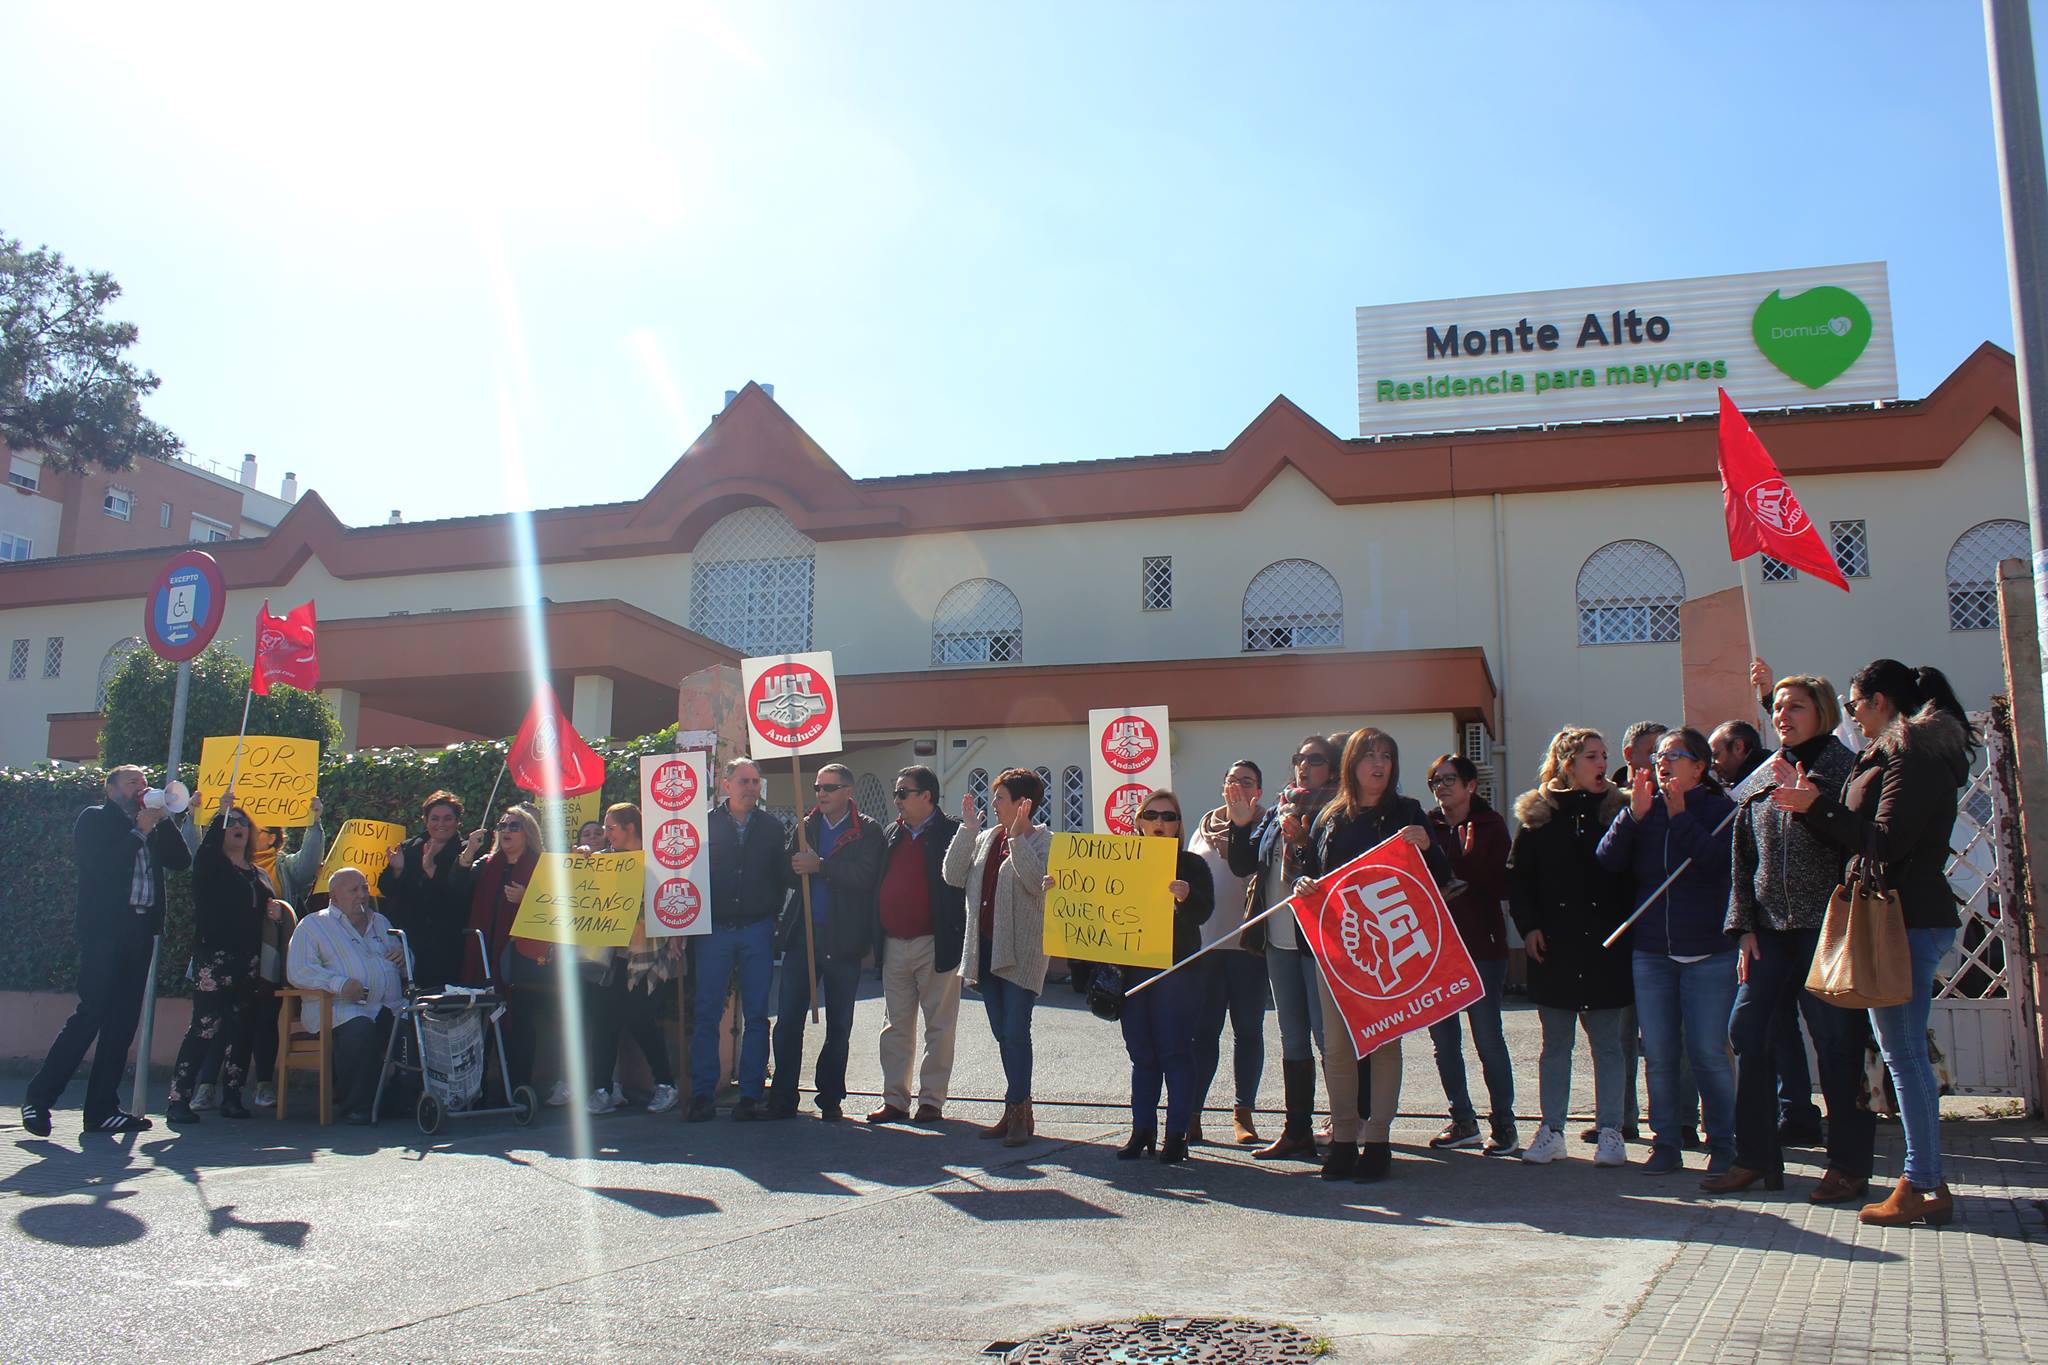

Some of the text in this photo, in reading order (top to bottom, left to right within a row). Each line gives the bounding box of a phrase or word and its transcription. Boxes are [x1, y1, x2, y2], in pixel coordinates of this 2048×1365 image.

[1426, 309, 1671, 360] Monte Alto
[1376, 359, 1728, 402] Residencia para mayores
[169, 574, 199, 584] EXCEPTO
[765, 672, 812, 699] UGT
[1112, 721, 1145, 740] UGT
[226, 743, 298, 773] POR
[660, 764, 687, 780] UGT
[662, 823, 690, 838] UGT
[562, 857, 636, 873] DERECHO
[575, 879, 600, 891] AL
[664, 882, 691, 898] UGT
[1055, 868, 1095, 893] TODO
[535, 892, 635, 911] DESCANSO
[524, 913, 626, 933] SEMANAL
[1358, 876, 1433, 971] UGT
[1065, 922, 1112, 947] PARA
[1361, 977, 1471, 1039] www.UGT.es
